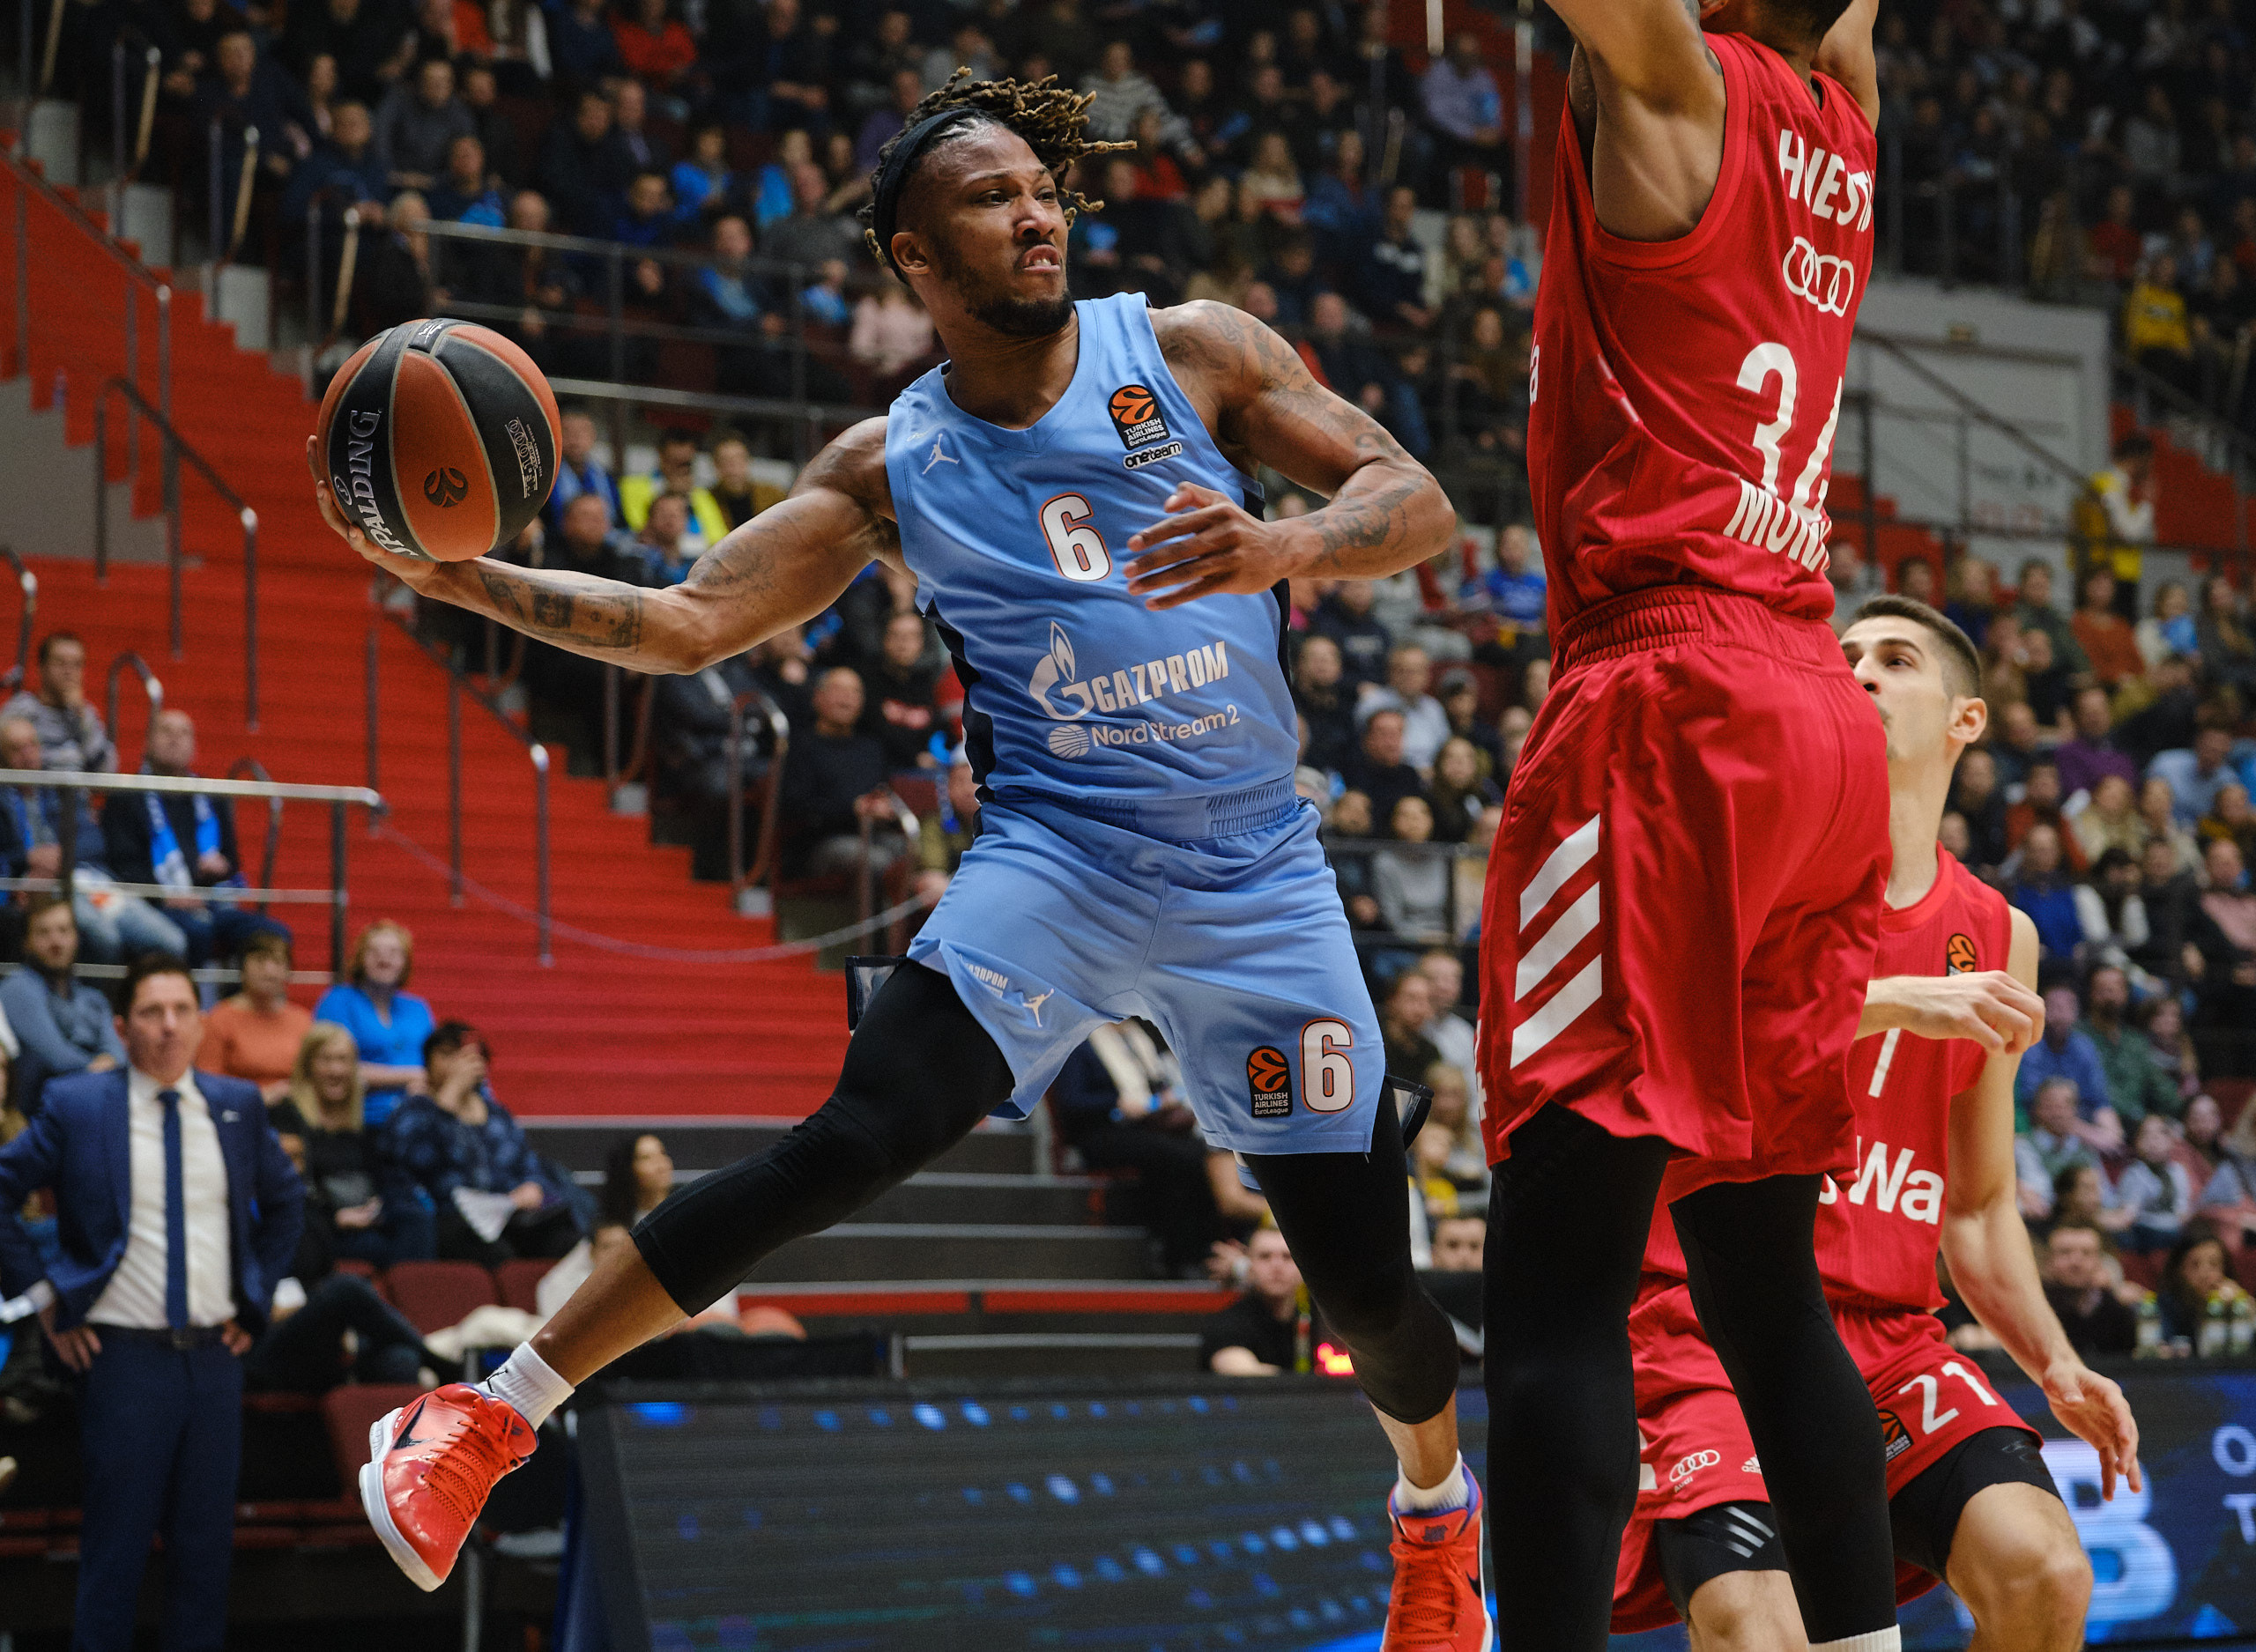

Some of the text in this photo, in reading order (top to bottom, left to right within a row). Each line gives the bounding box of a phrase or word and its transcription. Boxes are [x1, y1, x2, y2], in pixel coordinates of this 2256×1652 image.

[1124, 418, 1162, 436] TURKISH
[1127, 424, 1164, 442] AIRLINES
[348, 409, 419, 558] SPALDING
[1038, 491, 1114, 582] 6
[1091, 641, 1229, 713] GAZPROM
[1254, 1092, 1288, 1101] TURKISH
[1300, 1017, 1356, 1115] 6
[1254, 1099, 1288, 1108] AIRLINES
[1897, 1360, 1999, 1435] 21
